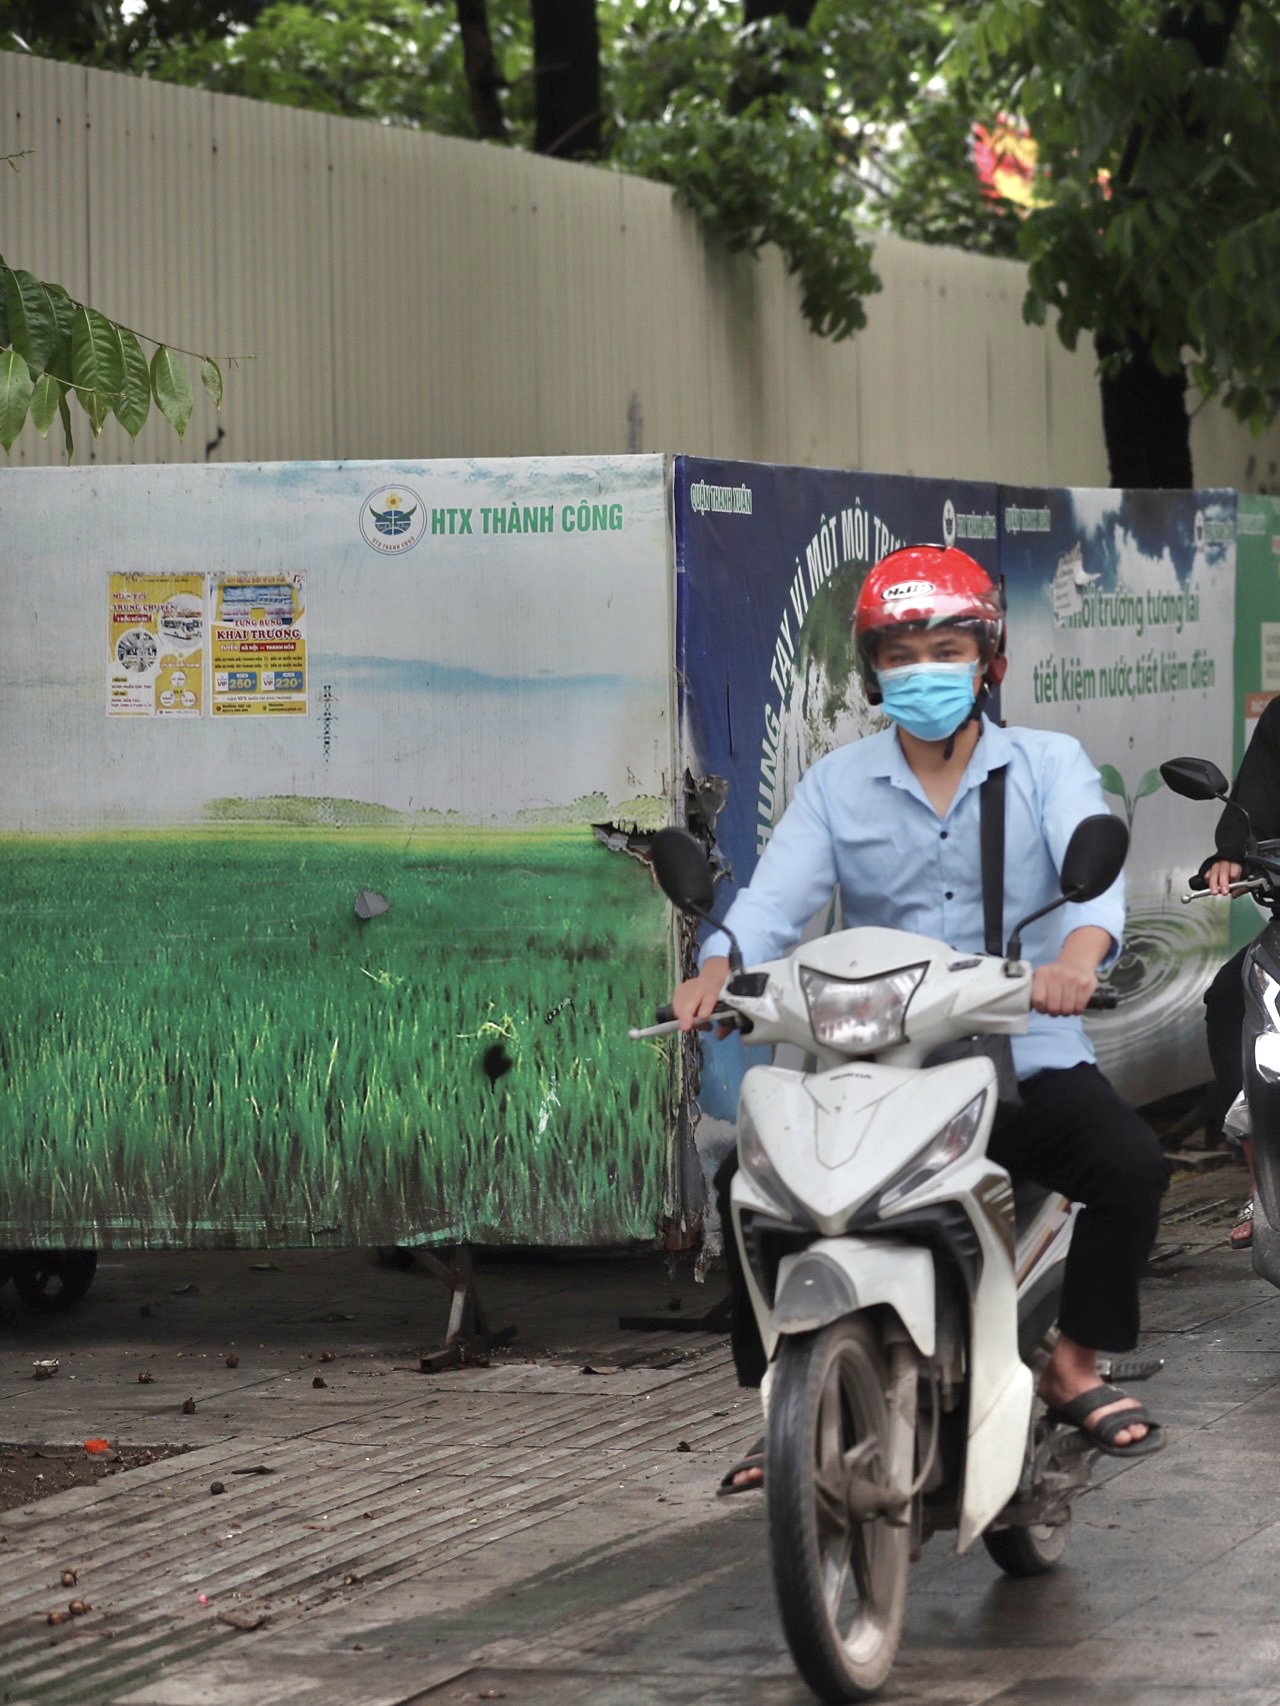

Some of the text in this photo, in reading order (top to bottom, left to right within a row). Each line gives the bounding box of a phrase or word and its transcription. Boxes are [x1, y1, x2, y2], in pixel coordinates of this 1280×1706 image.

[691, 479, 752, 516] QUẬN THANH XUÂN
[432, 499, 623, 535] HTX THÀNH CÔNG
[770, 608, 795, 701] TAY
[789, 556, 809, 629] VÌ
[806, 513, 839, 598] MỘT
[841, 496, 869, 562] MÔI
[217, 630, 248, 640] KHAI
[1033, 653, 1058, 704] tiết
[1061, 657, 1096, 713] kiệm
